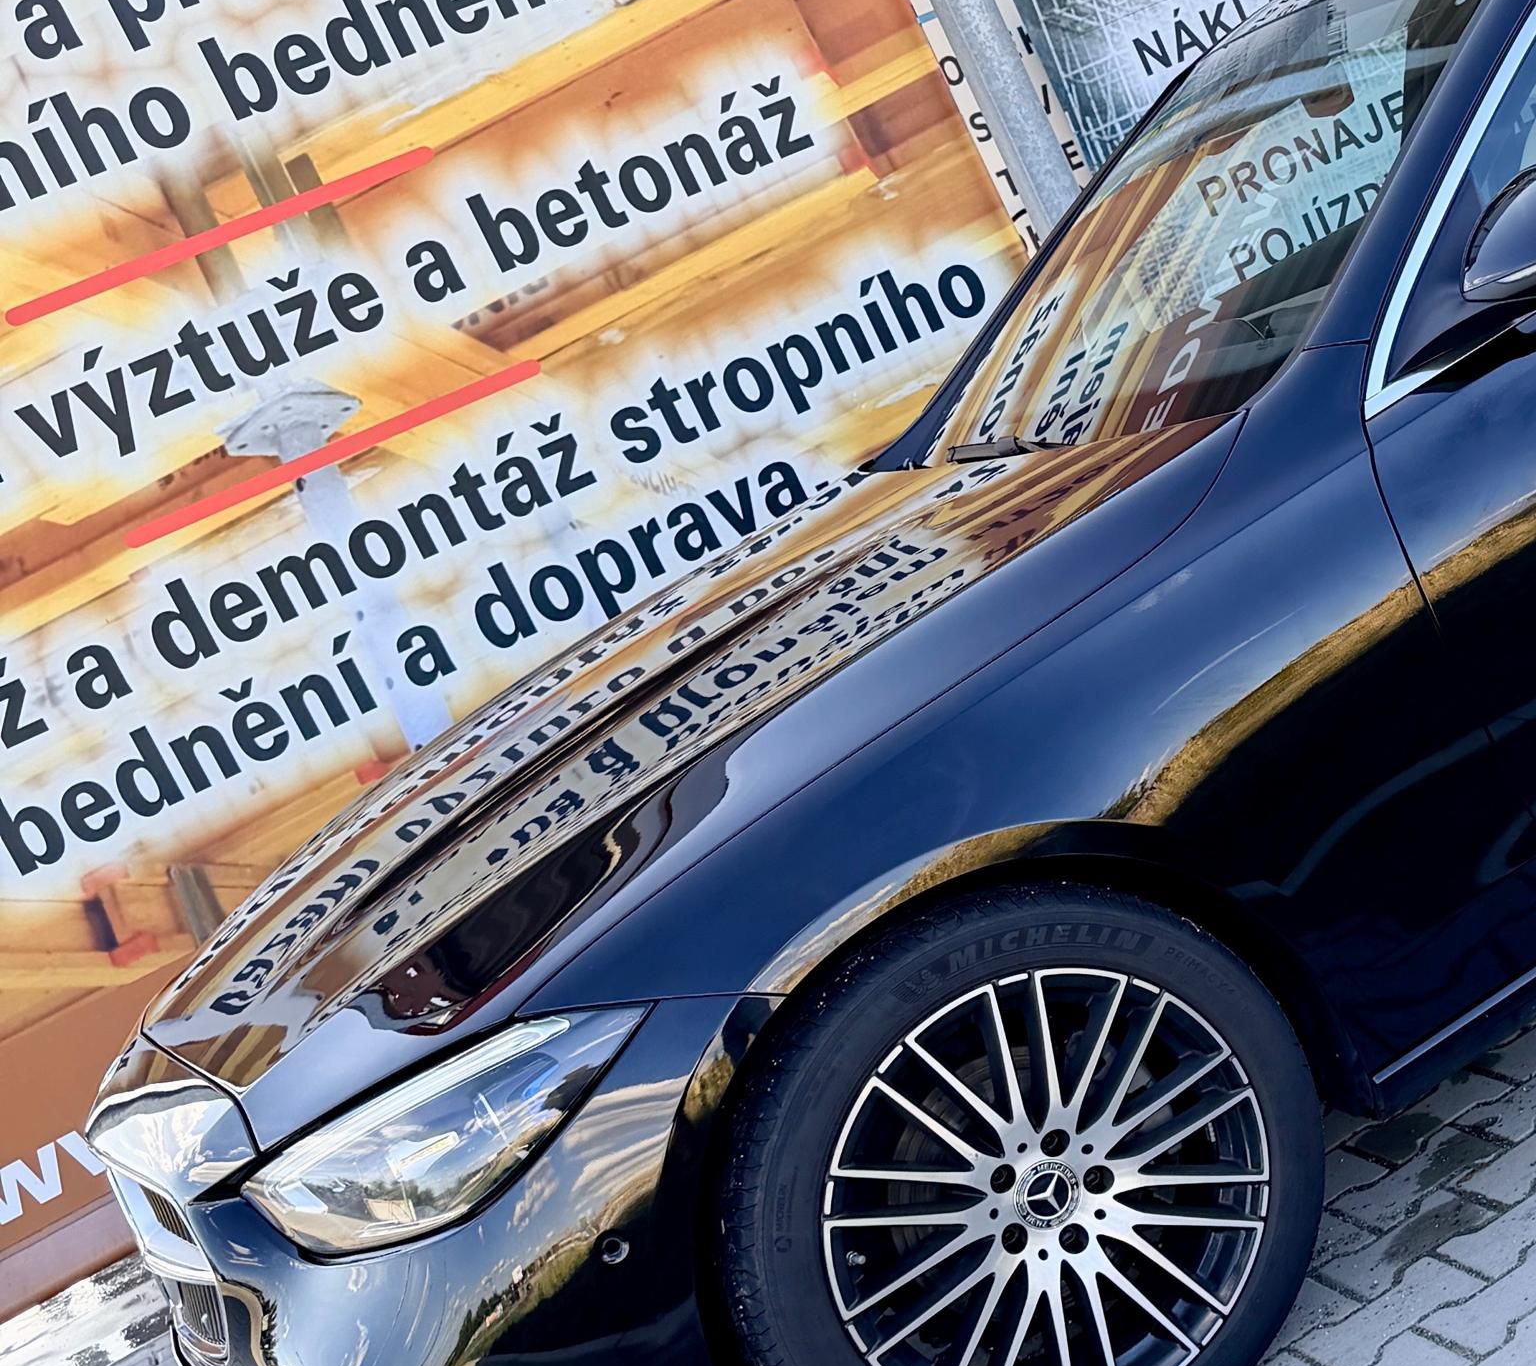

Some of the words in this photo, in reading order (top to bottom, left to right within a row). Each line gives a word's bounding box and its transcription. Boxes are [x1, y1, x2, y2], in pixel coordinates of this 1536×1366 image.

[15, 267, 386, 457] výztuže
[404, 237, 467, 305] a
[466, 75, 815, 276] betonáž
[66, 642, 133, 711] a
[150, 415, 598, 670] demontáž
[609, 259, 988, 466] stropního
[0, 633, 380, 877] bednění
[396, 620, 460, 688] a
[951, 924, 1143, 972] MICHELIN
